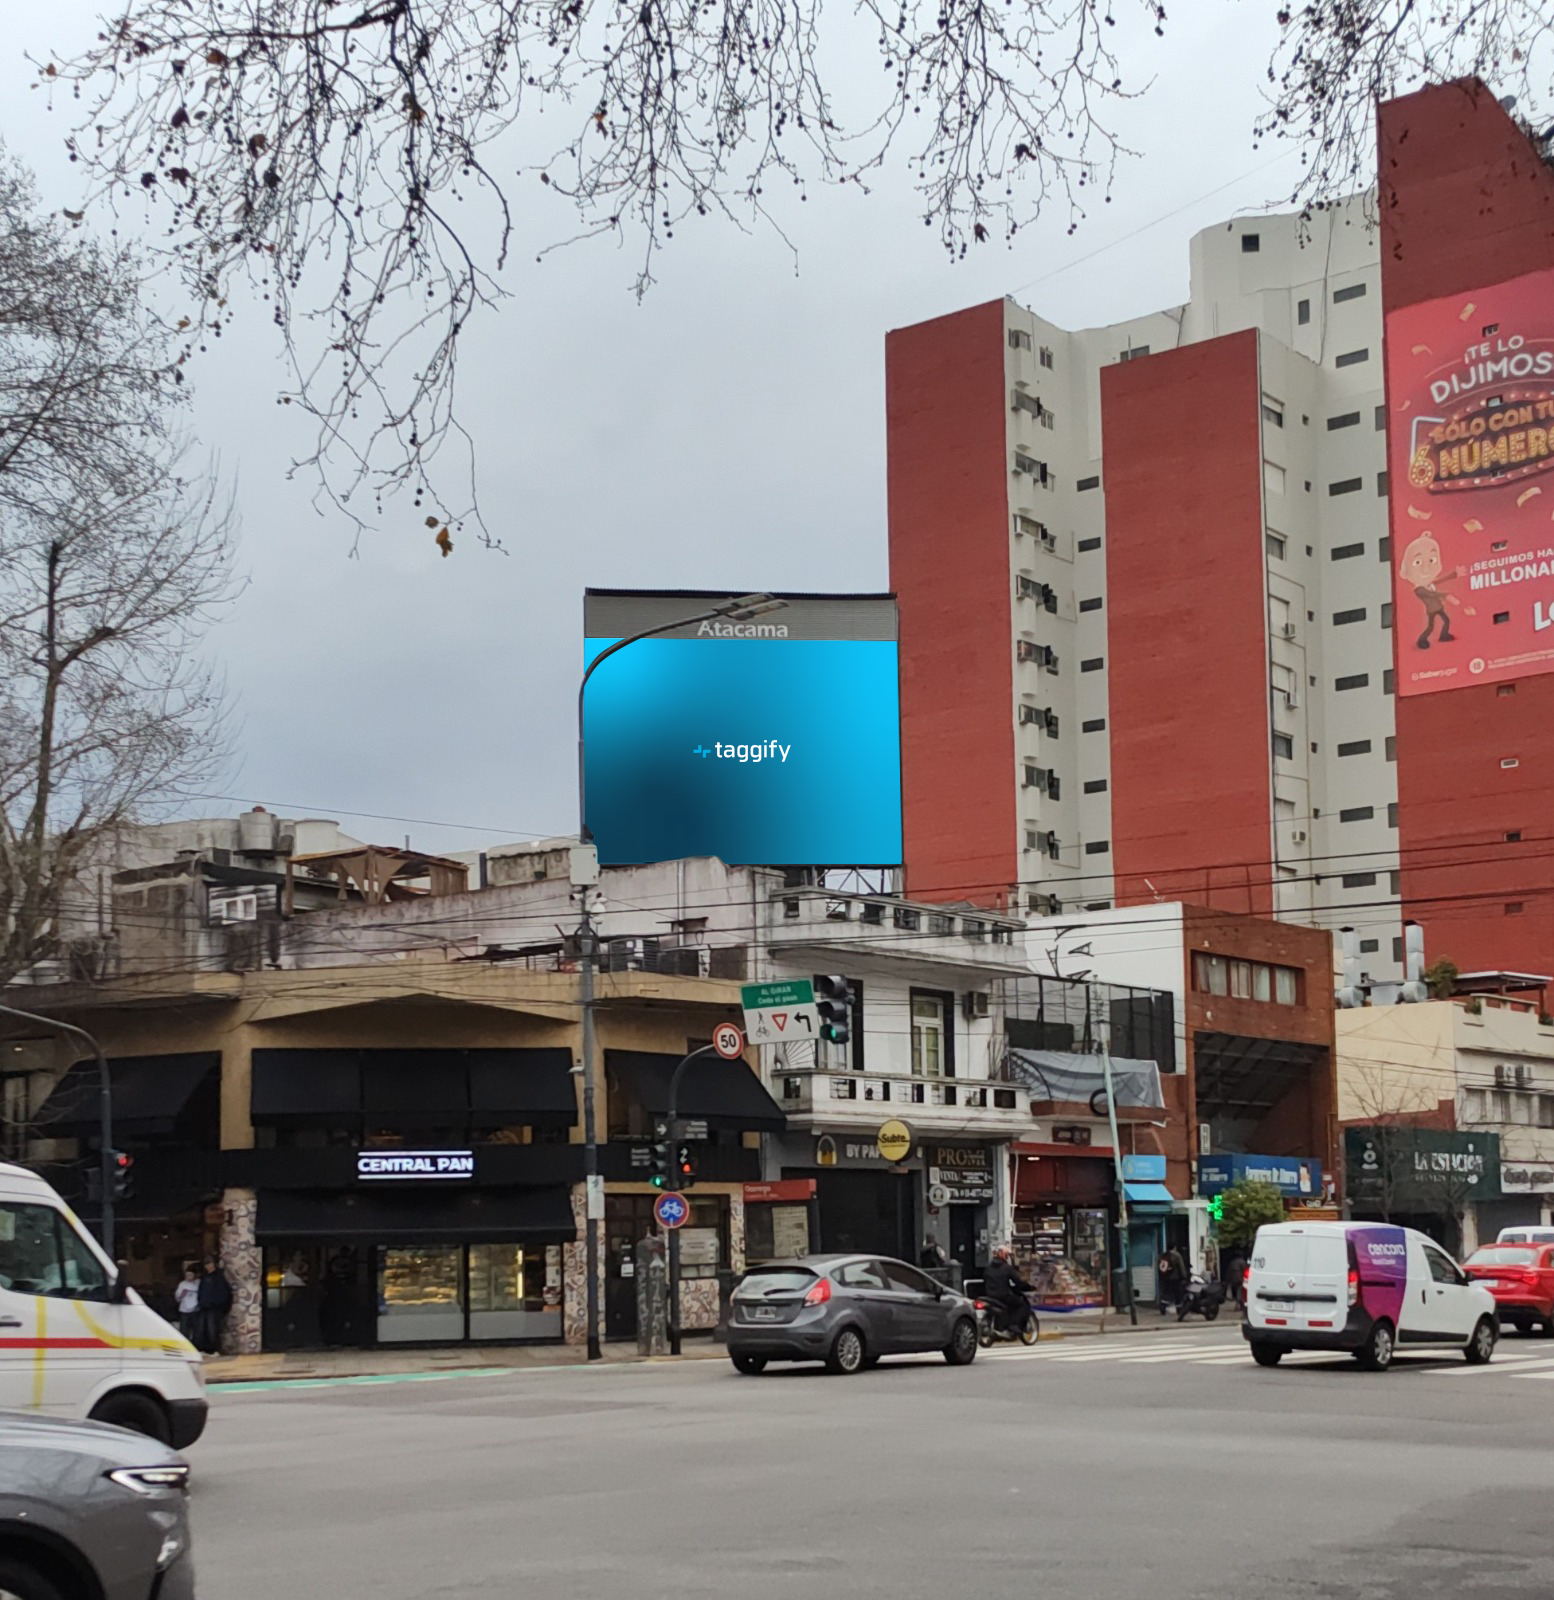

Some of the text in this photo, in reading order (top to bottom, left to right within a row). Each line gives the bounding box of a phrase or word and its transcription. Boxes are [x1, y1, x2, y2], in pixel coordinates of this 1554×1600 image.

[1464, 335, 1524, 364] ¡TE LO
[1488, 405, 1534, 432] CON
[1409, 444, 1435, 487] 6
[696, 620, 789, 638] Atacama
[715, 739, 792, 763] taggify
[720, 1034, 737, 1049] 50
[846, 1144, 860, 1158] BY
[358, 1157, 474, 1172] CENTRAL PAN
